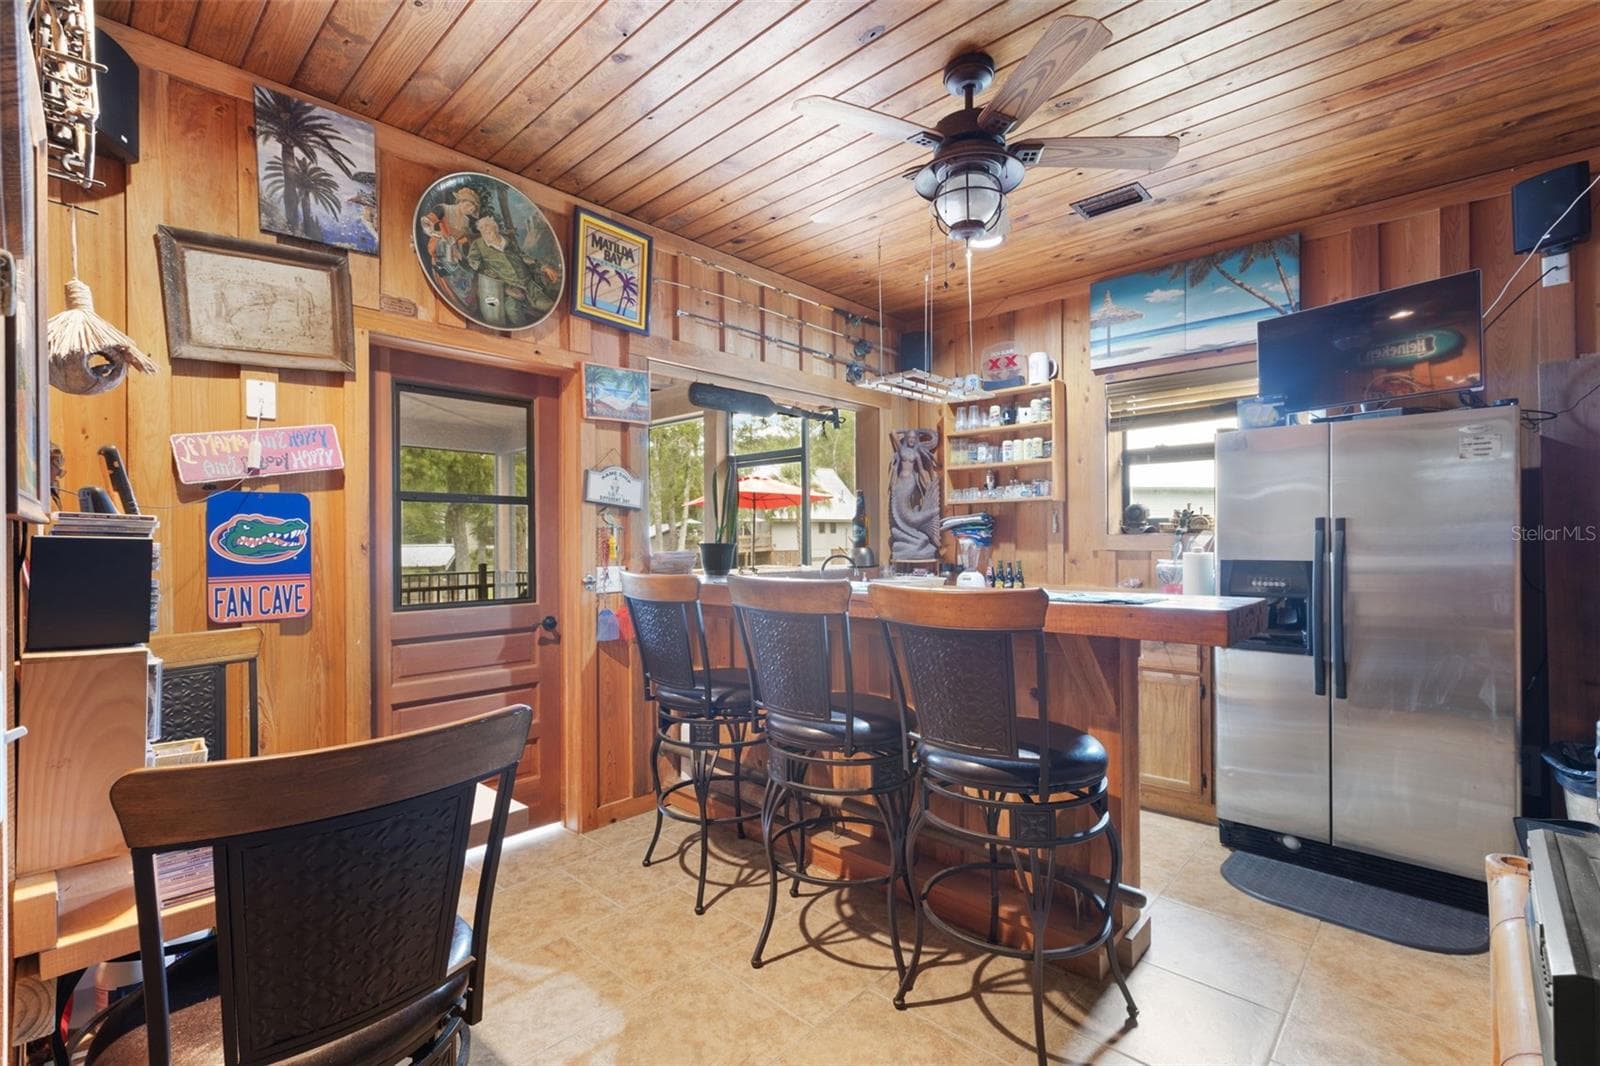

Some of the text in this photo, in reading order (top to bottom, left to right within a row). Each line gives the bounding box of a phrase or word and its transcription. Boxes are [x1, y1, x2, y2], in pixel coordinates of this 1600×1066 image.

[591, 232, 635, 264] MATILDA
[603, 250, 624, 267] BAY
[214, 584, 306, 618] FAN CAVE
